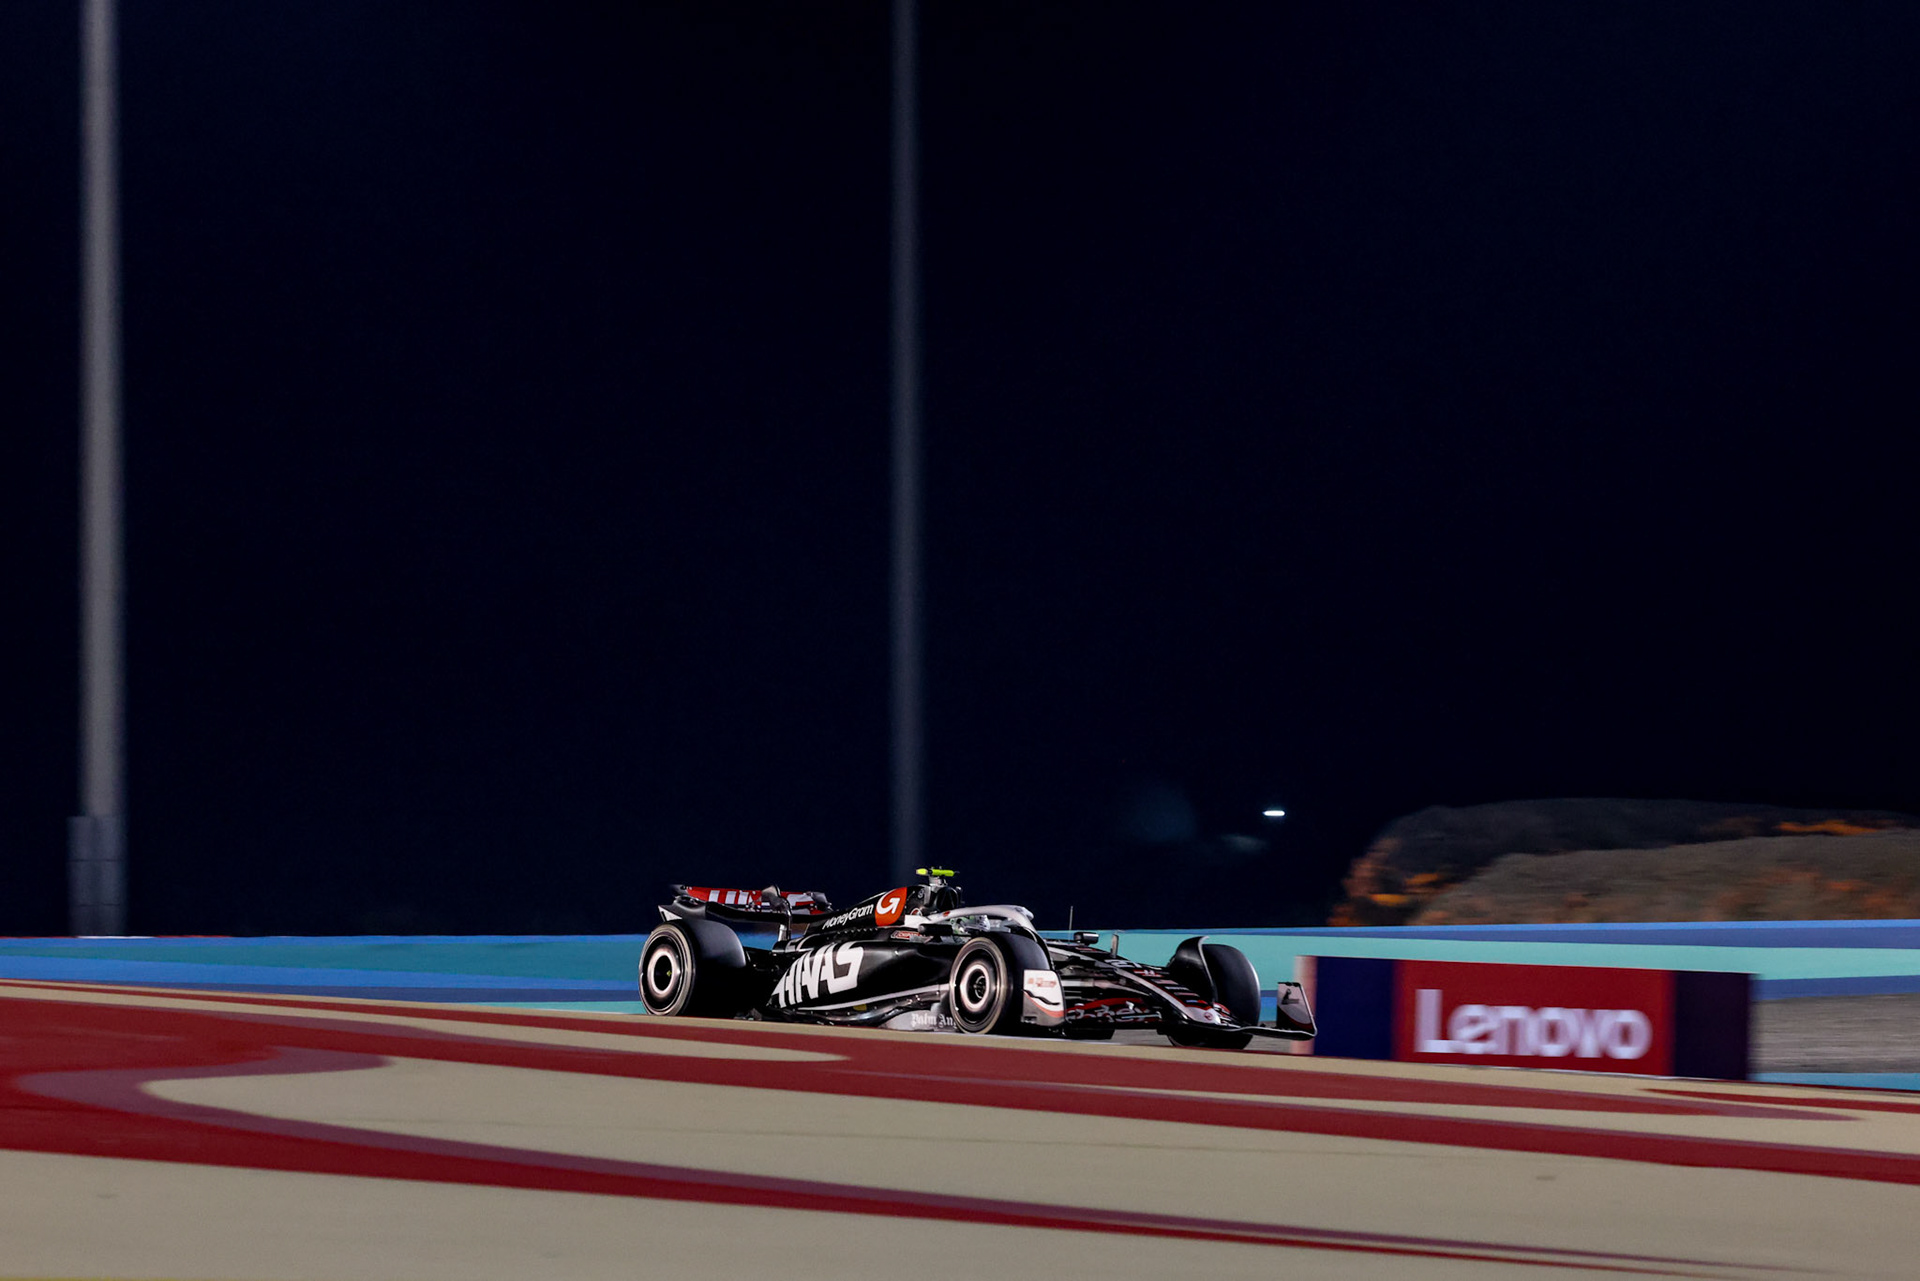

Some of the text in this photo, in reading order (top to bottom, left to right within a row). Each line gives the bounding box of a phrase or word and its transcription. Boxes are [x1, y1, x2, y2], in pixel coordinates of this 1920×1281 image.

[822, 903, 875, 930] MoneyGram
[771, 940, 864, 1008] HAAS
[911, 1012, 937, 1028] Palm
[1413, 988, 1653, 1060] Lenovo
